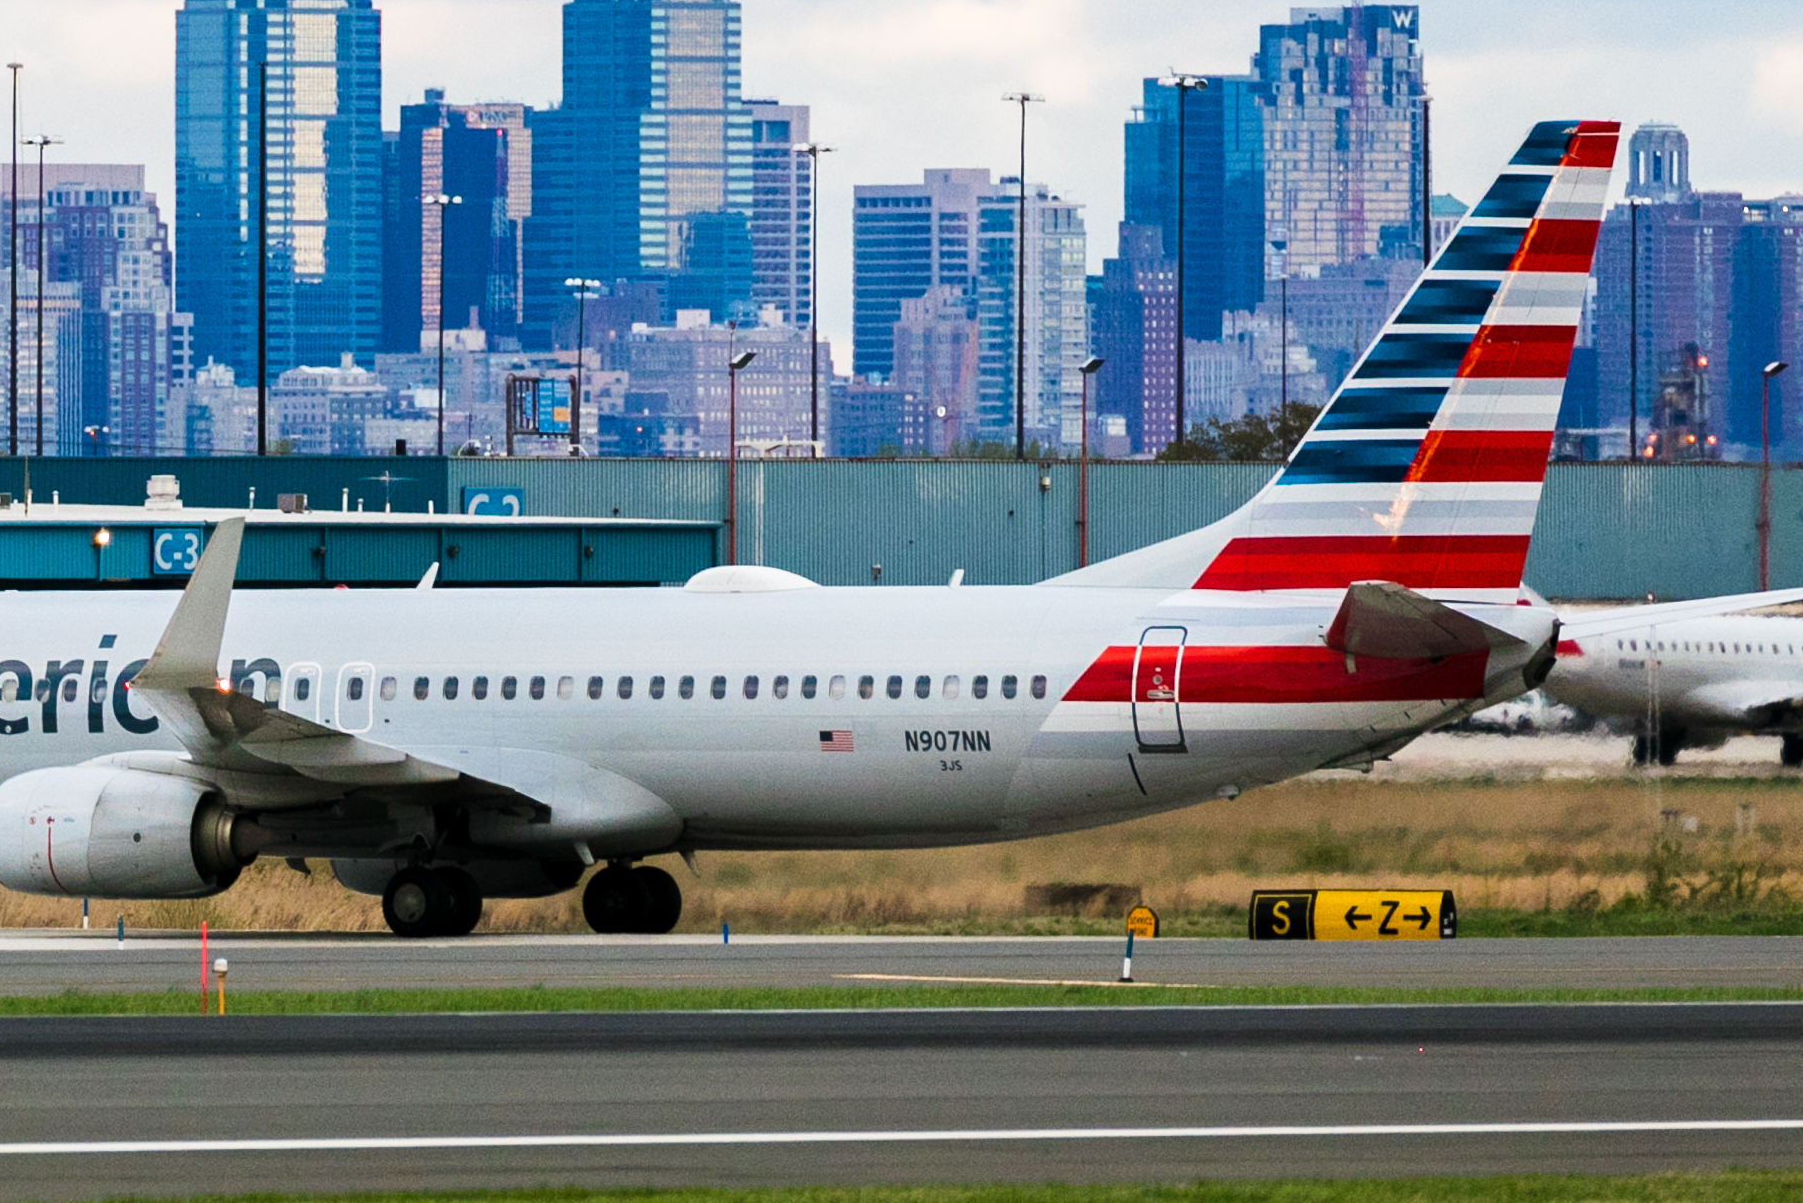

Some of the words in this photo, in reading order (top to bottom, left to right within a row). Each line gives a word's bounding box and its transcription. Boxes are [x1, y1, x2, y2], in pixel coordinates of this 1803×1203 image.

[1392, 9, 1413, 29] W
[154, 532, 199, 571] C-3
[904, 730, 992, 752] N907NN
[939, 759, 963, 772] 3JS
[1271, 900, 1291, 935] S
[1378, 900, 1401, 935] Z
